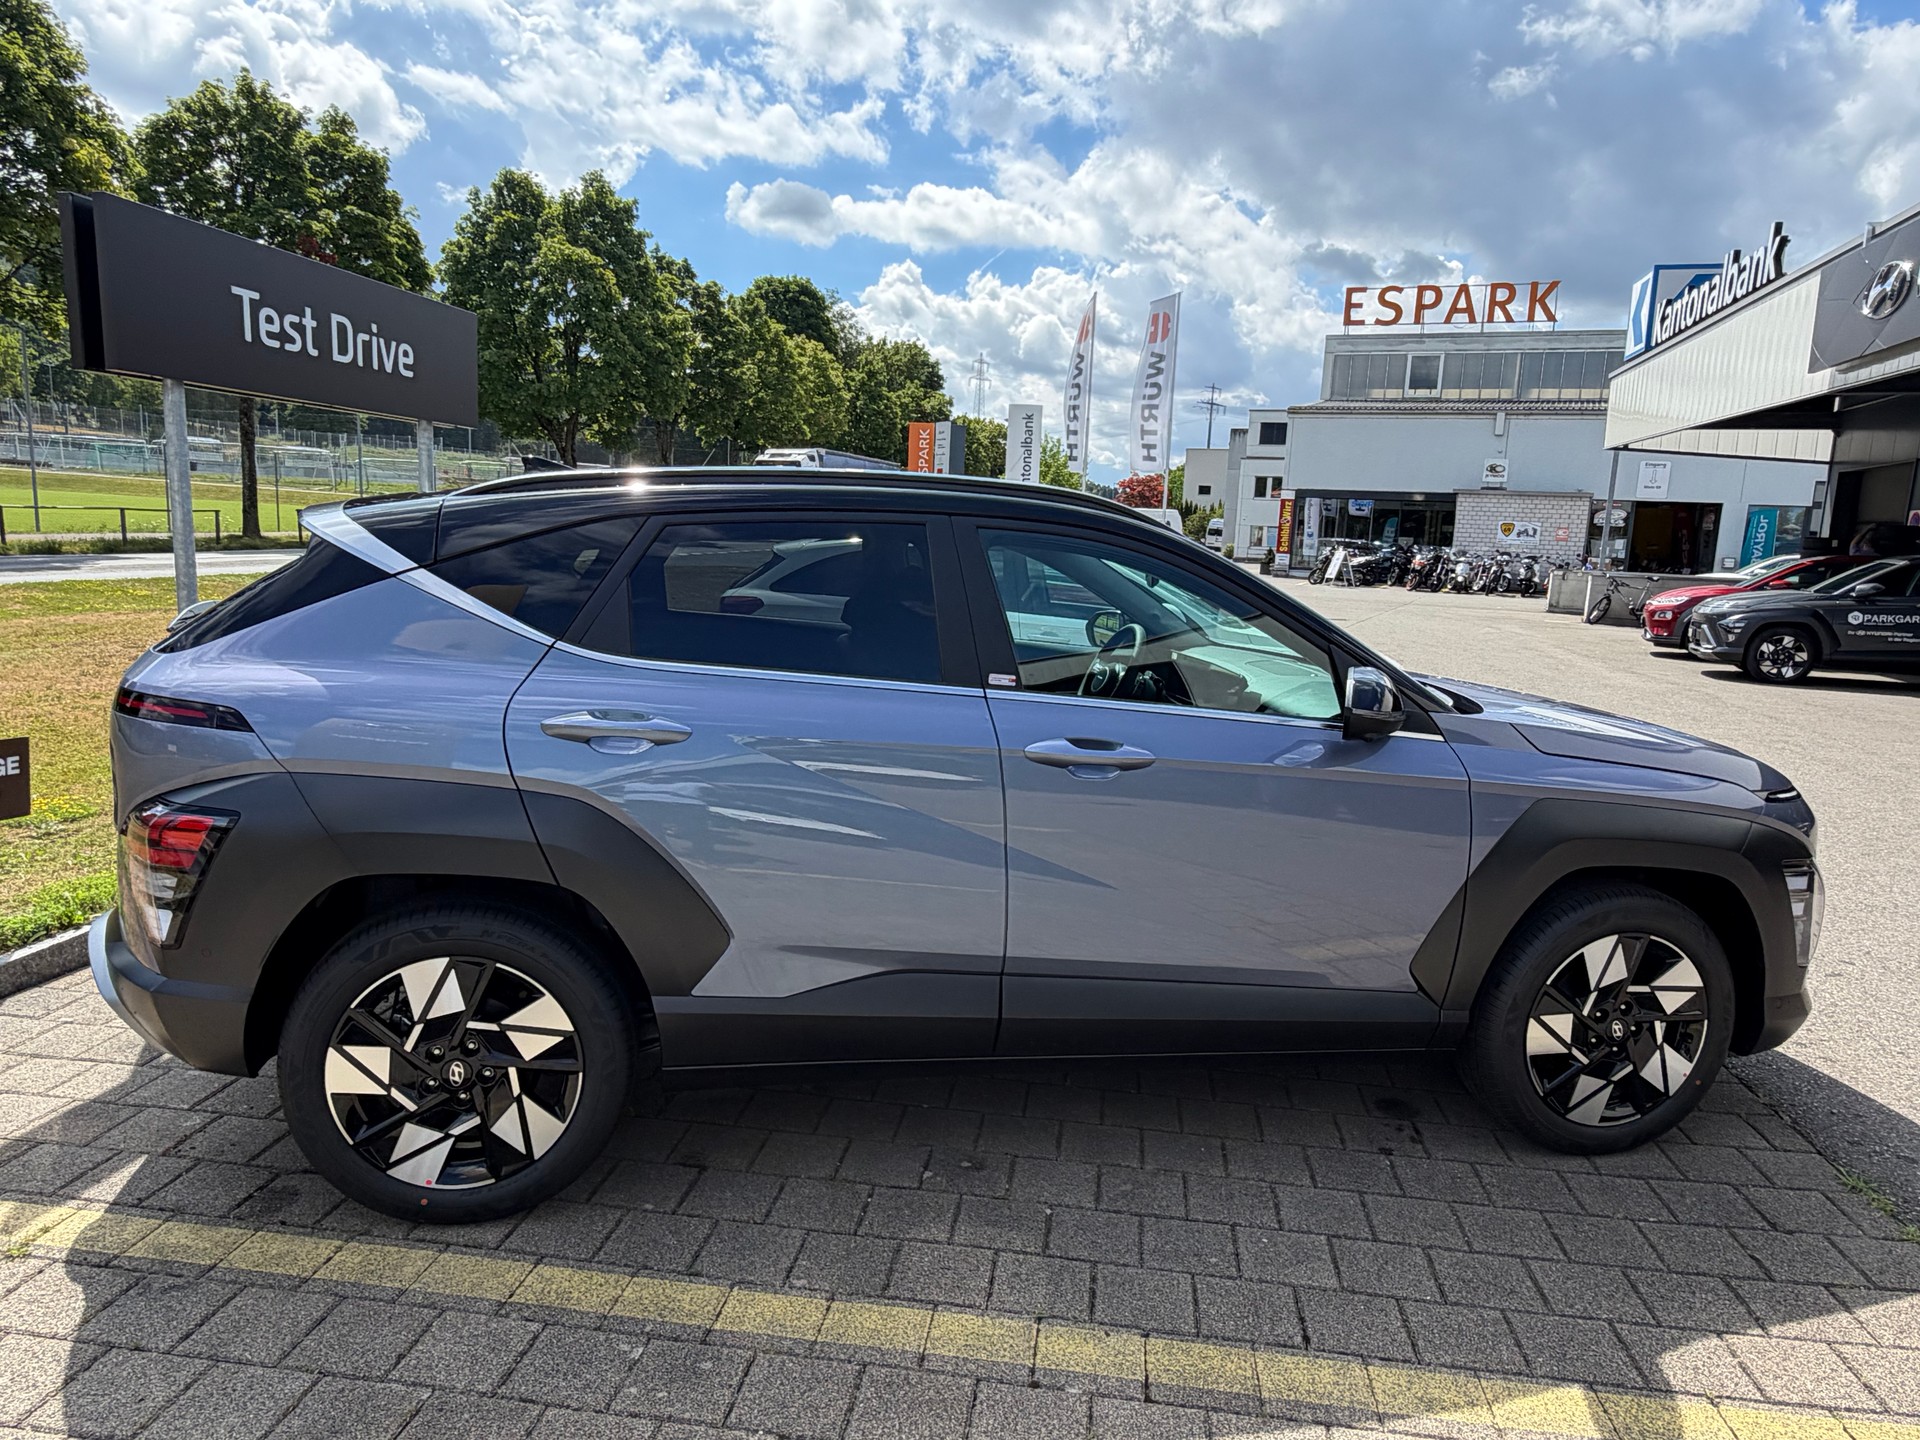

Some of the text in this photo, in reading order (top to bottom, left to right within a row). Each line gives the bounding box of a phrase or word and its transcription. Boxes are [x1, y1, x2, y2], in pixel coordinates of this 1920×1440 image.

[1343, 280, 1562, 326] ESPARK
[1651, 222, 1787, 346] Kantonalbank
[231, 285, 414, 378] Test Drive
